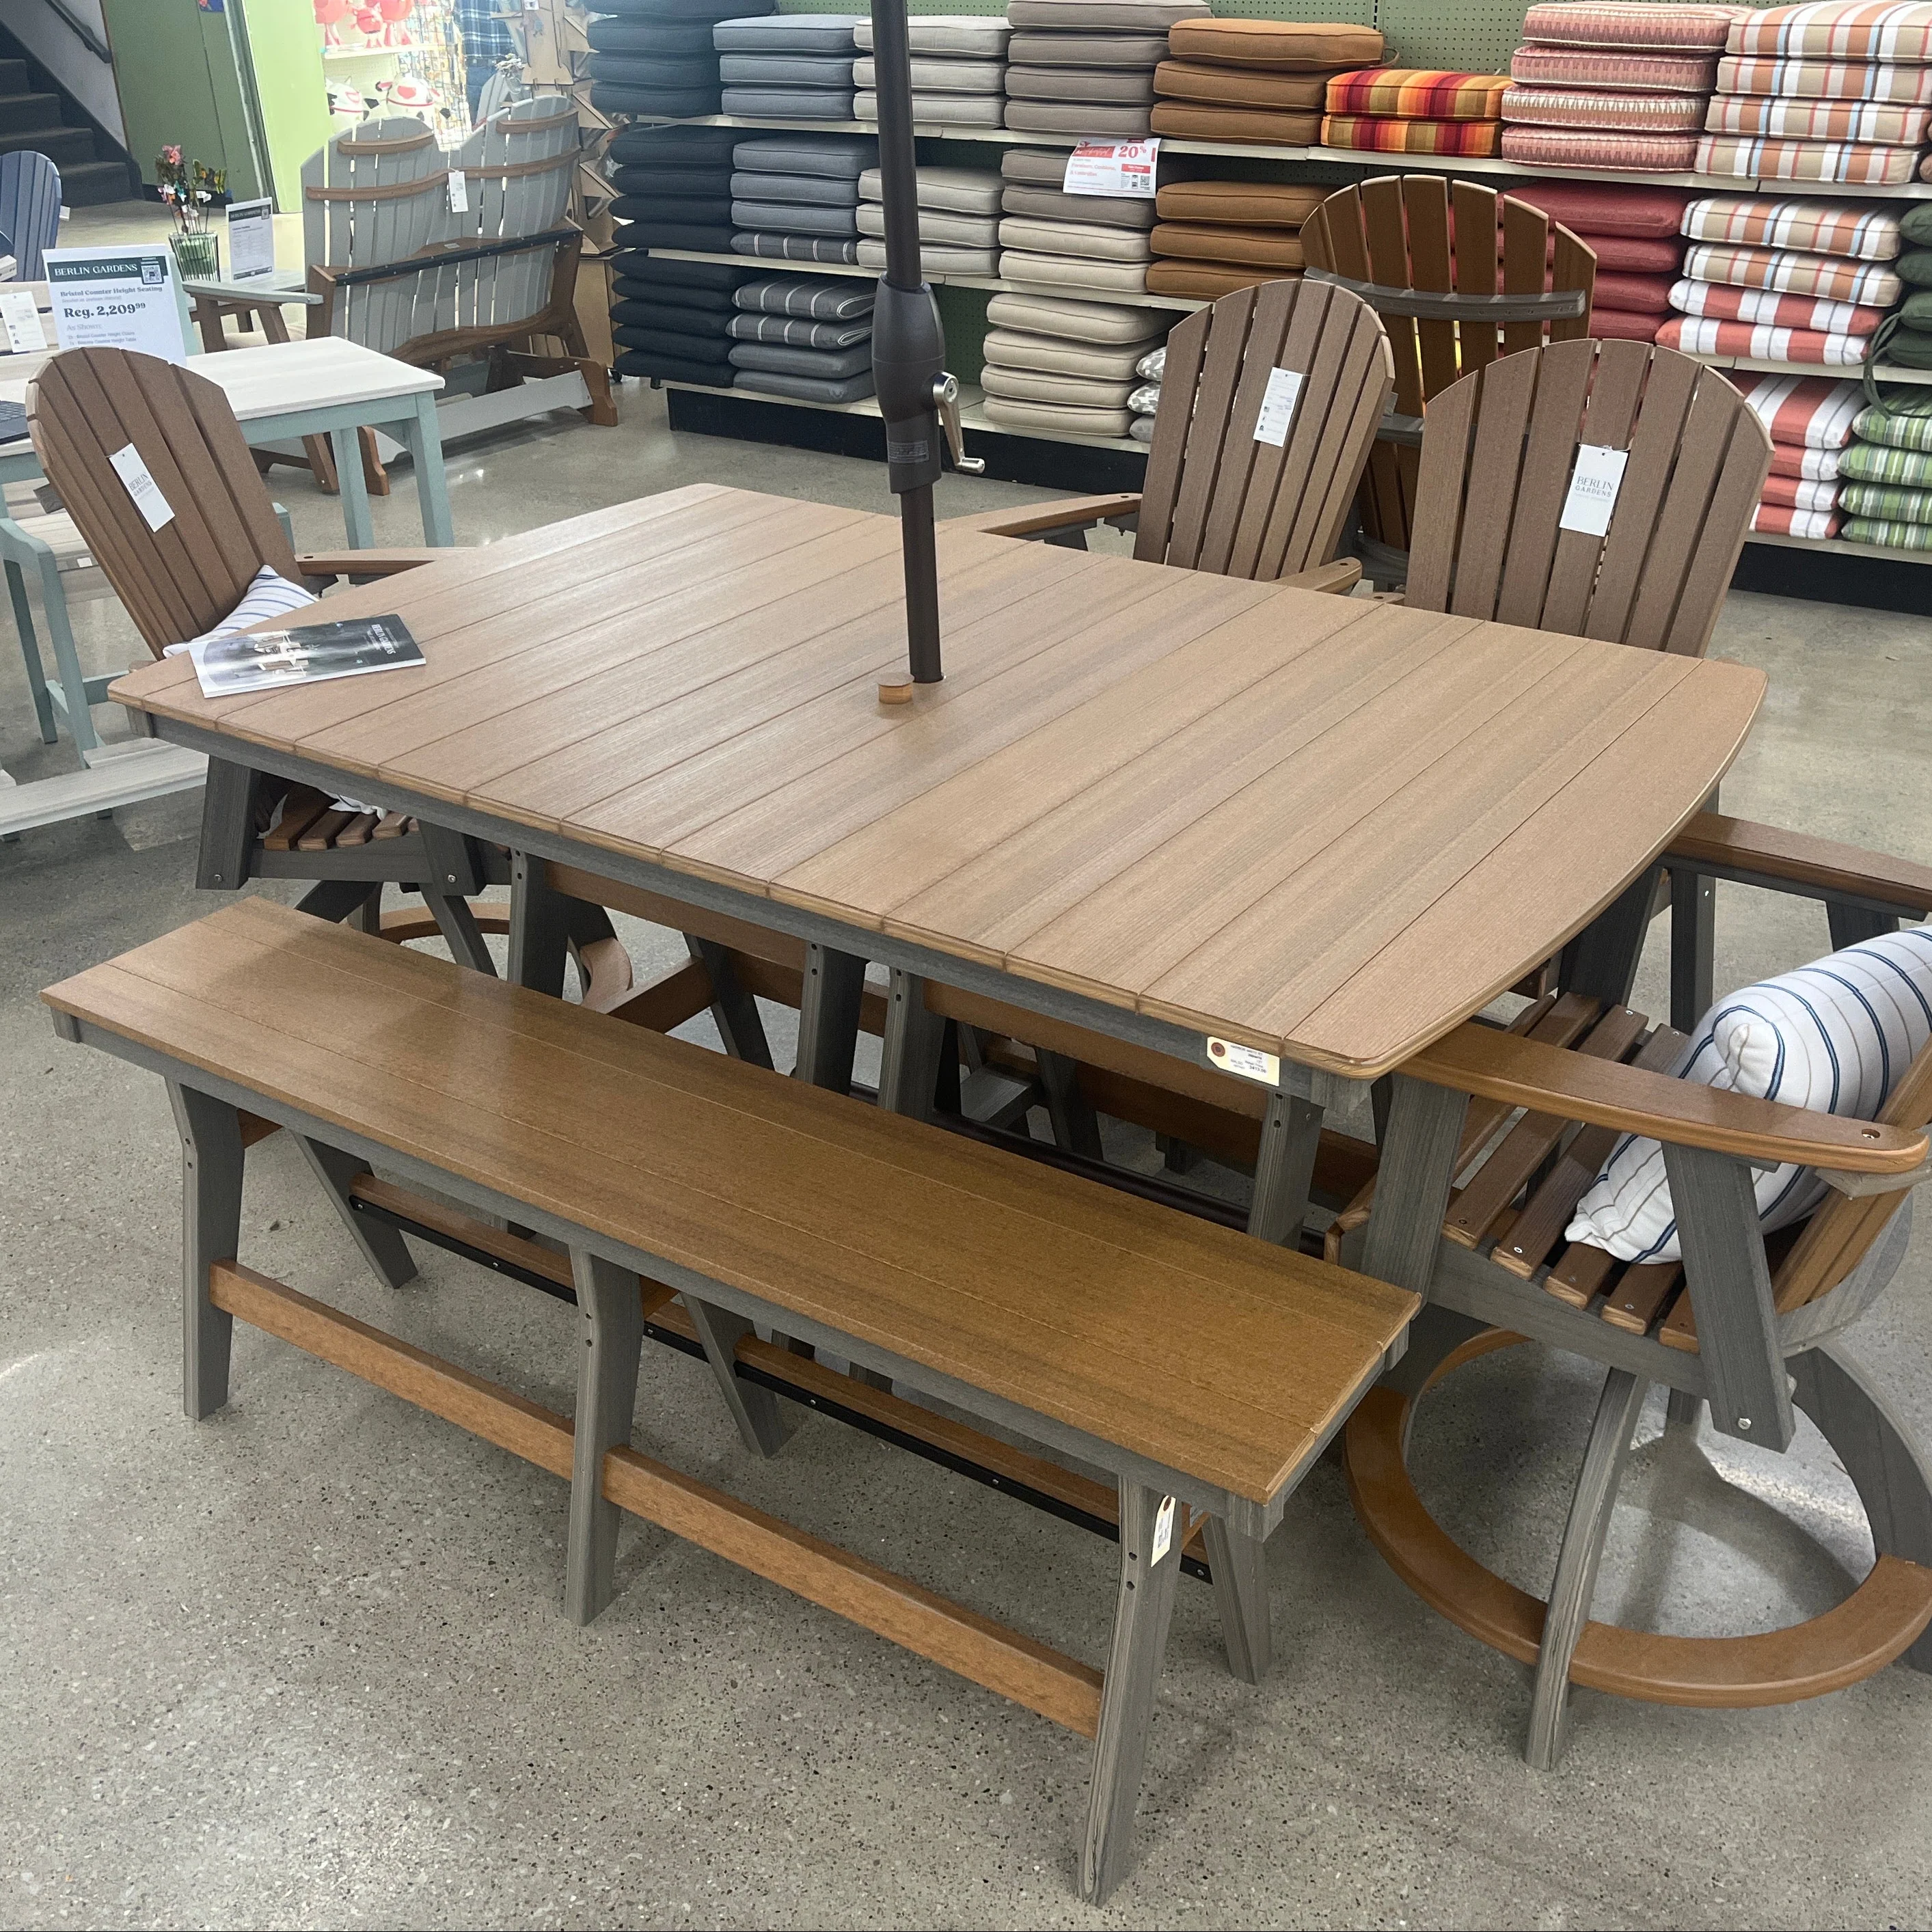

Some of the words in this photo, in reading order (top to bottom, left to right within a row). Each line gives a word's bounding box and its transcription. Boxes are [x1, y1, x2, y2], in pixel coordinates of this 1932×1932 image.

[54, 267, 90, 276] BERLIN
[92, 264, 137, 274] GARDENS
[64, 308, 94, 319] Reg.
[1577, 476, 1614, 491] BERLIN
[1575, 485, 1611, 498] GARDENS
